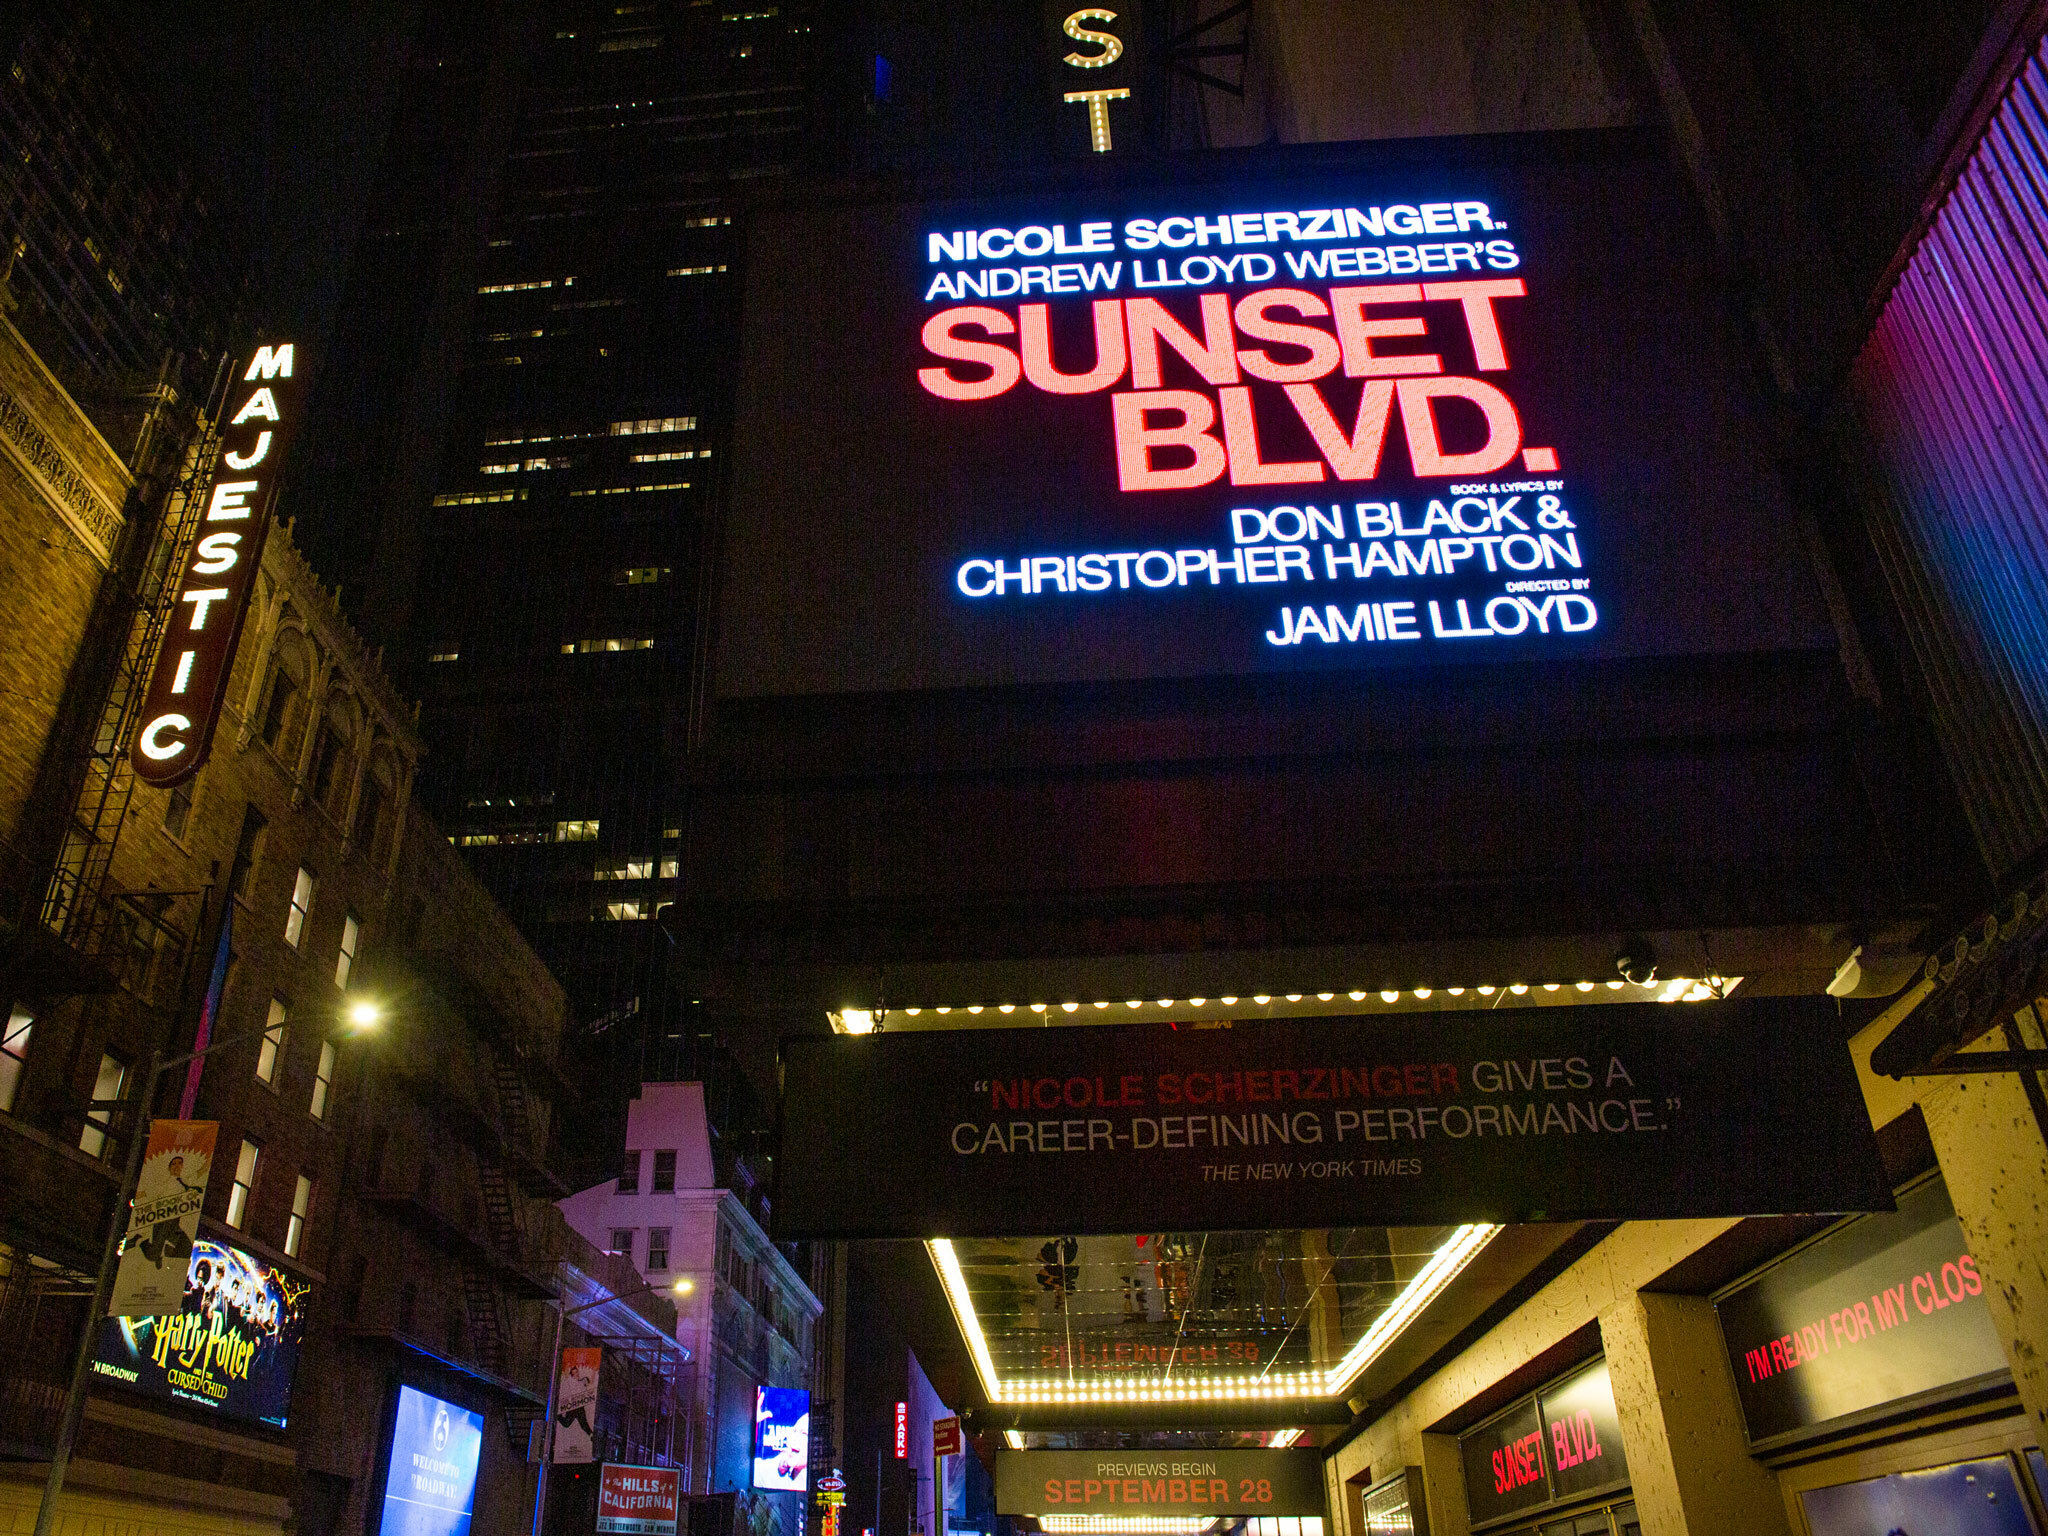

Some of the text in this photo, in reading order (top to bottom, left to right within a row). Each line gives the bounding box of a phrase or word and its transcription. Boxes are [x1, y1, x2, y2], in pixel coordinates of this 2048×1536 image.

[928, 201, 1494, 264] NICOLE SCHERZINGER
[925, 240, 1520, 301] ANDREW LLOYD WEBBER'S
[917, 277, 1528, 402] SUNSET
[1110, 376, 1560, 492] BLVD.
[1450, 479, 1564, 495] BOOK & LYRICS BY
[1231, 494, 1577, 546] DON BLACK &
[139, 343, 296, 760] MAJESTIC
[956, 532, 1582, 597] CHRISTOPHER HAMPTON
[1505, 578, 1590, 593] DIRECTED BY
[1265, 593, 1599, 646] JAMIE LLOYD
[974, 1056, 1634, 1110] “NICOLE SCHERZINGER GIVES A
[951, 1097, 1681, 1155] CAREER-DEFINING PERFORMANCE.”
[1202, 1158, 1422, 1182] THE NEW YORK TIMES
[135, 1199, 200, 1227] MORMON
[151, 1311, 255, 1385] Harry Potter
[1745, 1346, 1774, 1383] I'M
[1770, 1322, 1830, 1374] READY
[1829, 1301, 1876, 1350] FOR
[1871, 1284, 1909, 1332] MY
[101, 1362, 139, 1383] BROADWAY
[168, 1369, 228, 1400] CURSED CHILD
[561, 1395, 596, 1411] MORMON
[897, 1415, 905, 1448] PARK
[1492, 1409, 1602, 1495] SUNSET BLVD.
[413, 1453, 449, 1476] WELCOME
[622, 1477, 659, 1493] HILLS
[1097, 1462, 1216, 1476] PREVIEWS BEGIN
[604, 1490, 673, 1511] CALIFORNIA
[1044, 1478, 1273, 1503] SEPTEMBER 28
